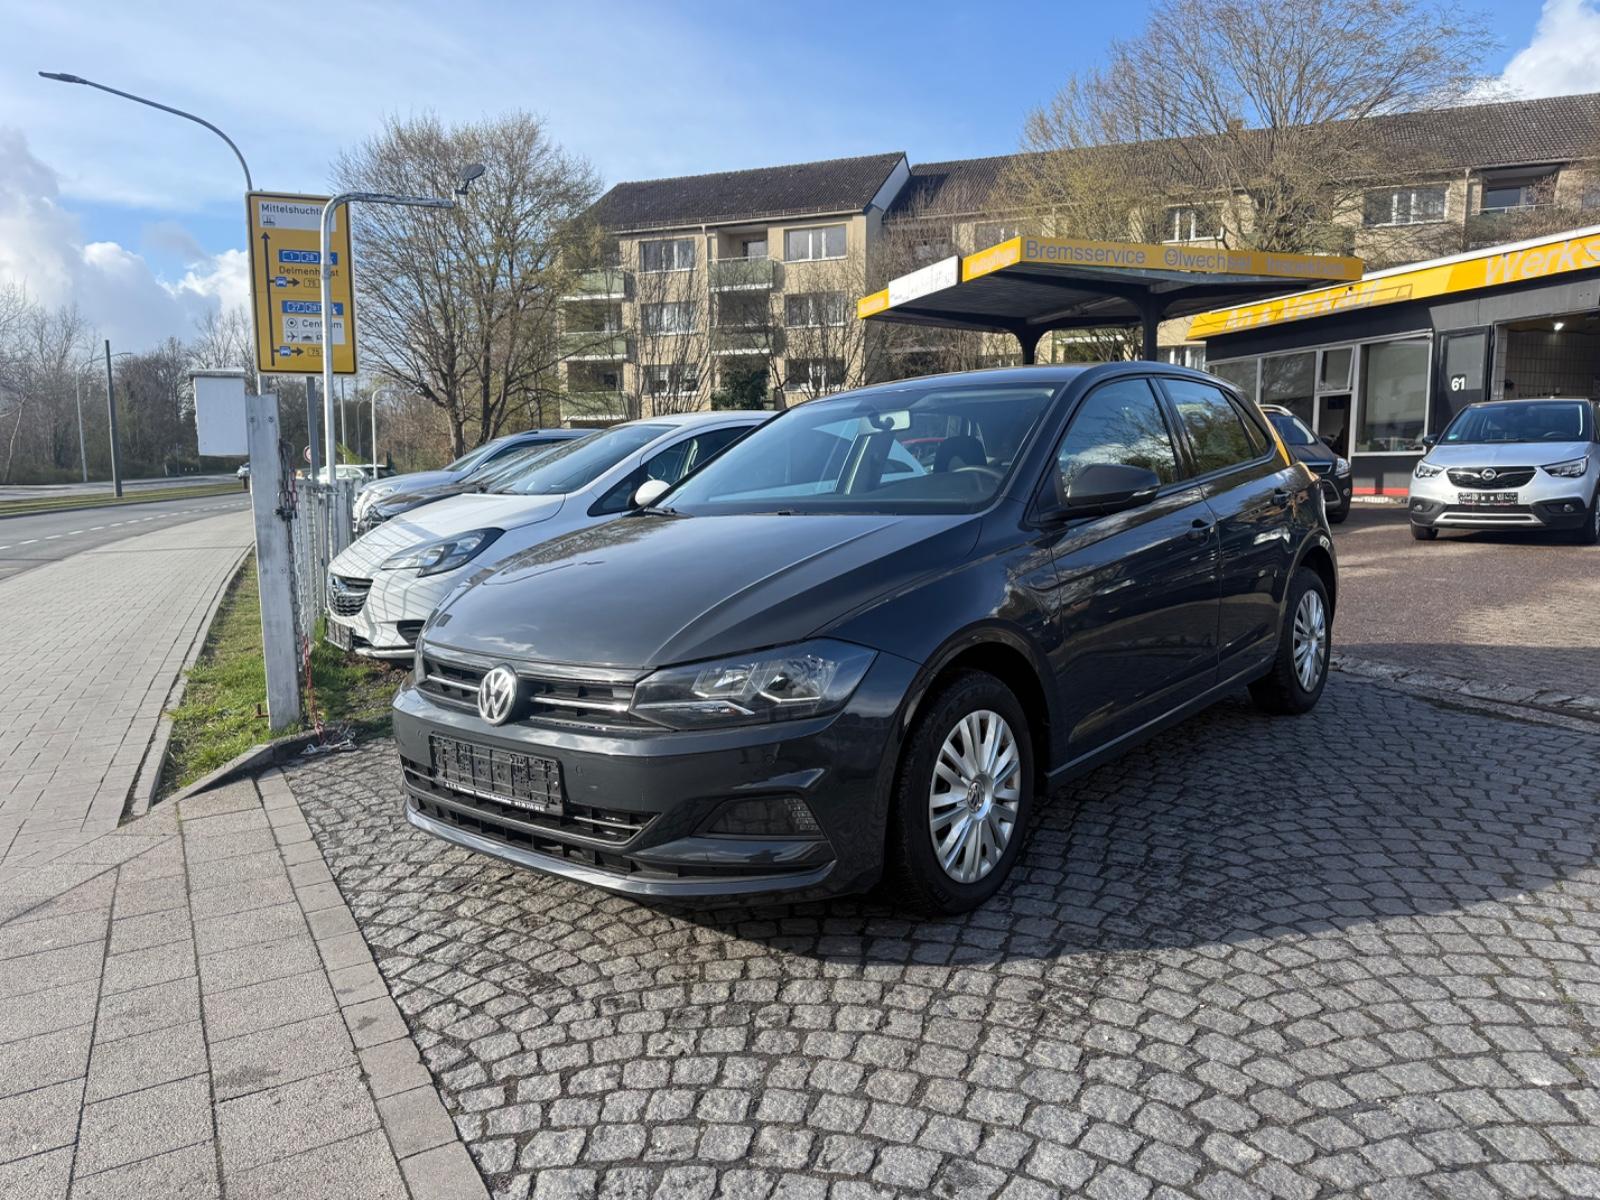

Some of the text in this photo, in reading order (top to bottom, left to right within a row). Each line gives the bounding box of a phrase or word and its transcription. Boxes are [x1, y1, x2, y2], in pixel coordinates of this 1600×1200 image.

[1026, 240, 1145, 264] Bremsservice
[279, 265, 339, 277] Delmenhst
[1451, 376, 1465, 391] 61
